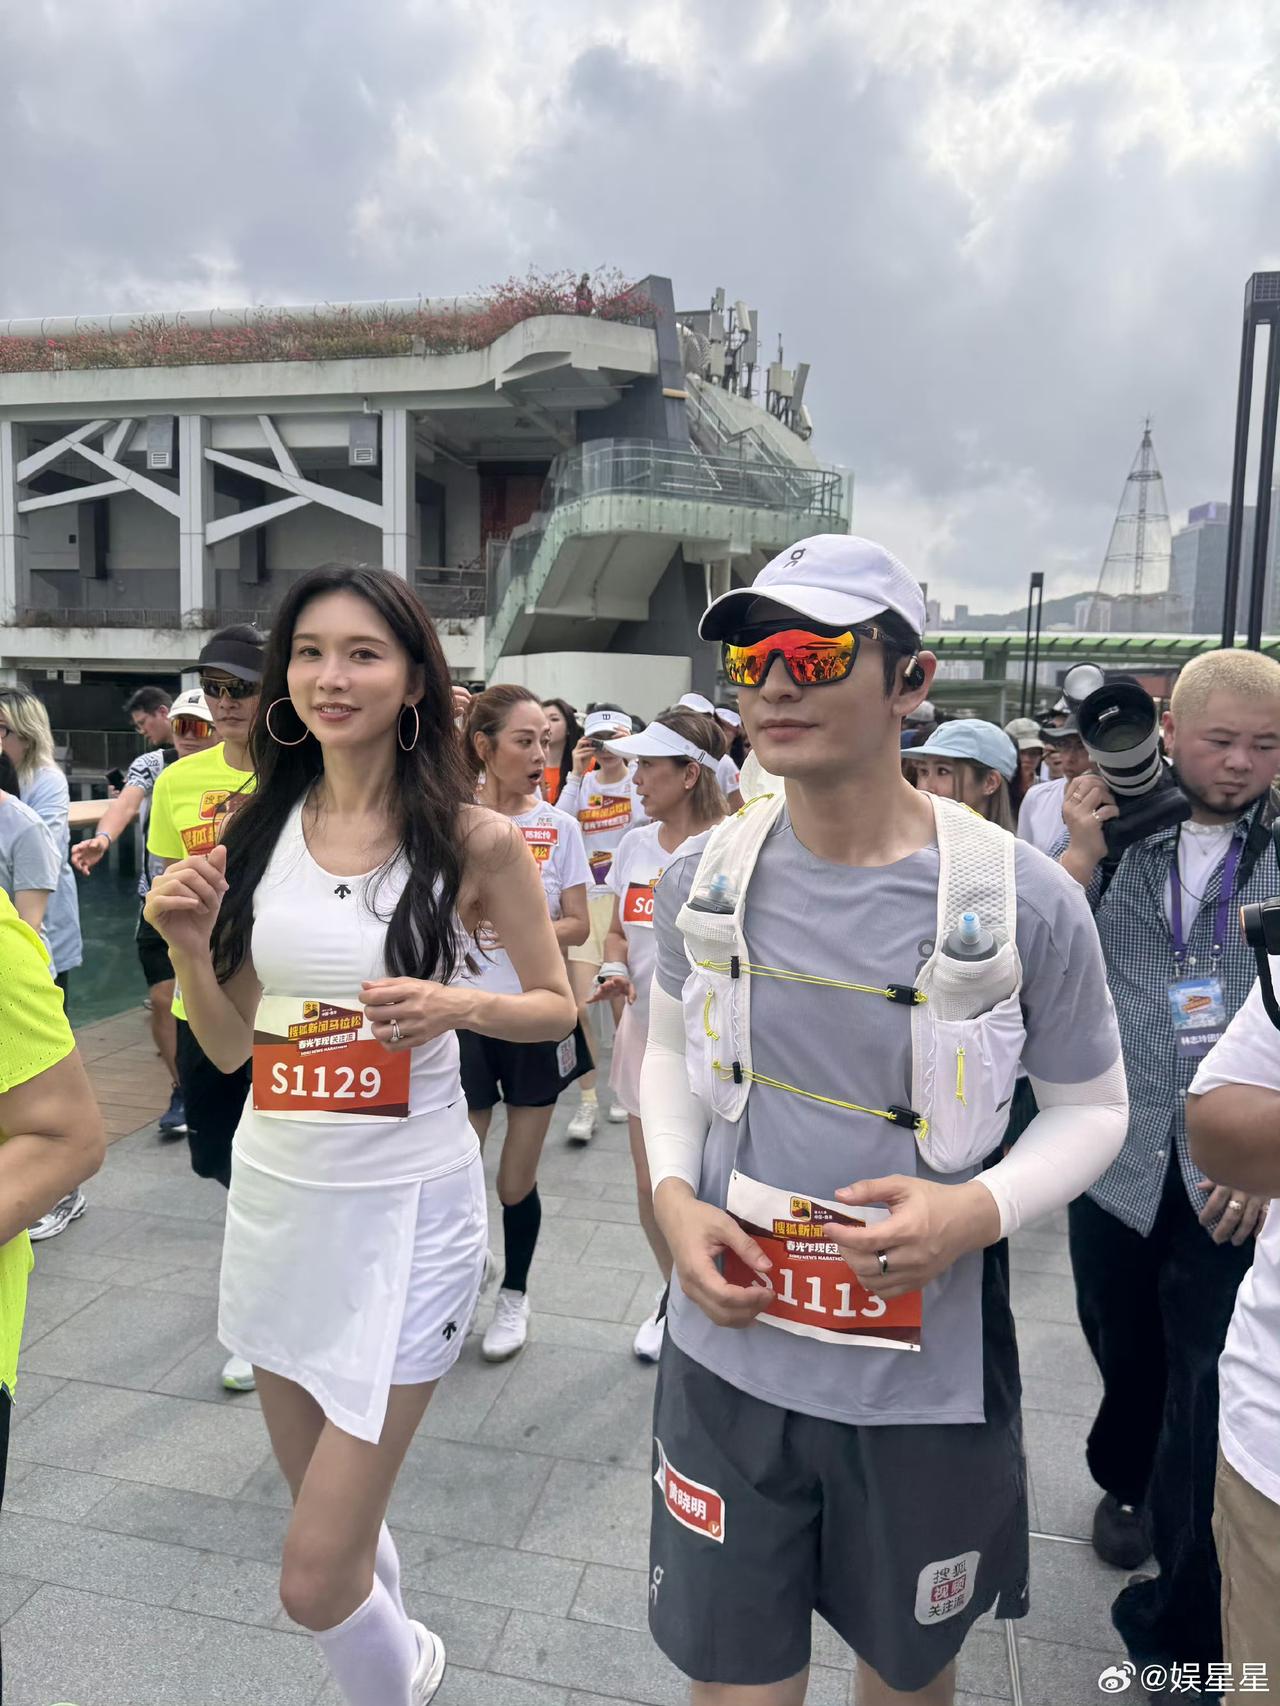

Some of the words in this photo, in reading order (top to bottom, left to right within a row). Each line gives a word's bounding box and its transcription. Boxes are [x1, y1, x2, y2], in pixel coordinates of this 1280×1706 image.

[288, 1015, 362, 1038] 搜狐新闻马拉松
[270, 1061, 383, 1099] S1129
[774, 1221, 825, 1238] 搜狐新闻
[786, 1240, 839, 1254] 春光乍现关
[668, 1479, 707, 1521] 黄晓明
[933, 1559, 968, 1585] 搜狐
[934, 1577, 966, 1601] 视频
